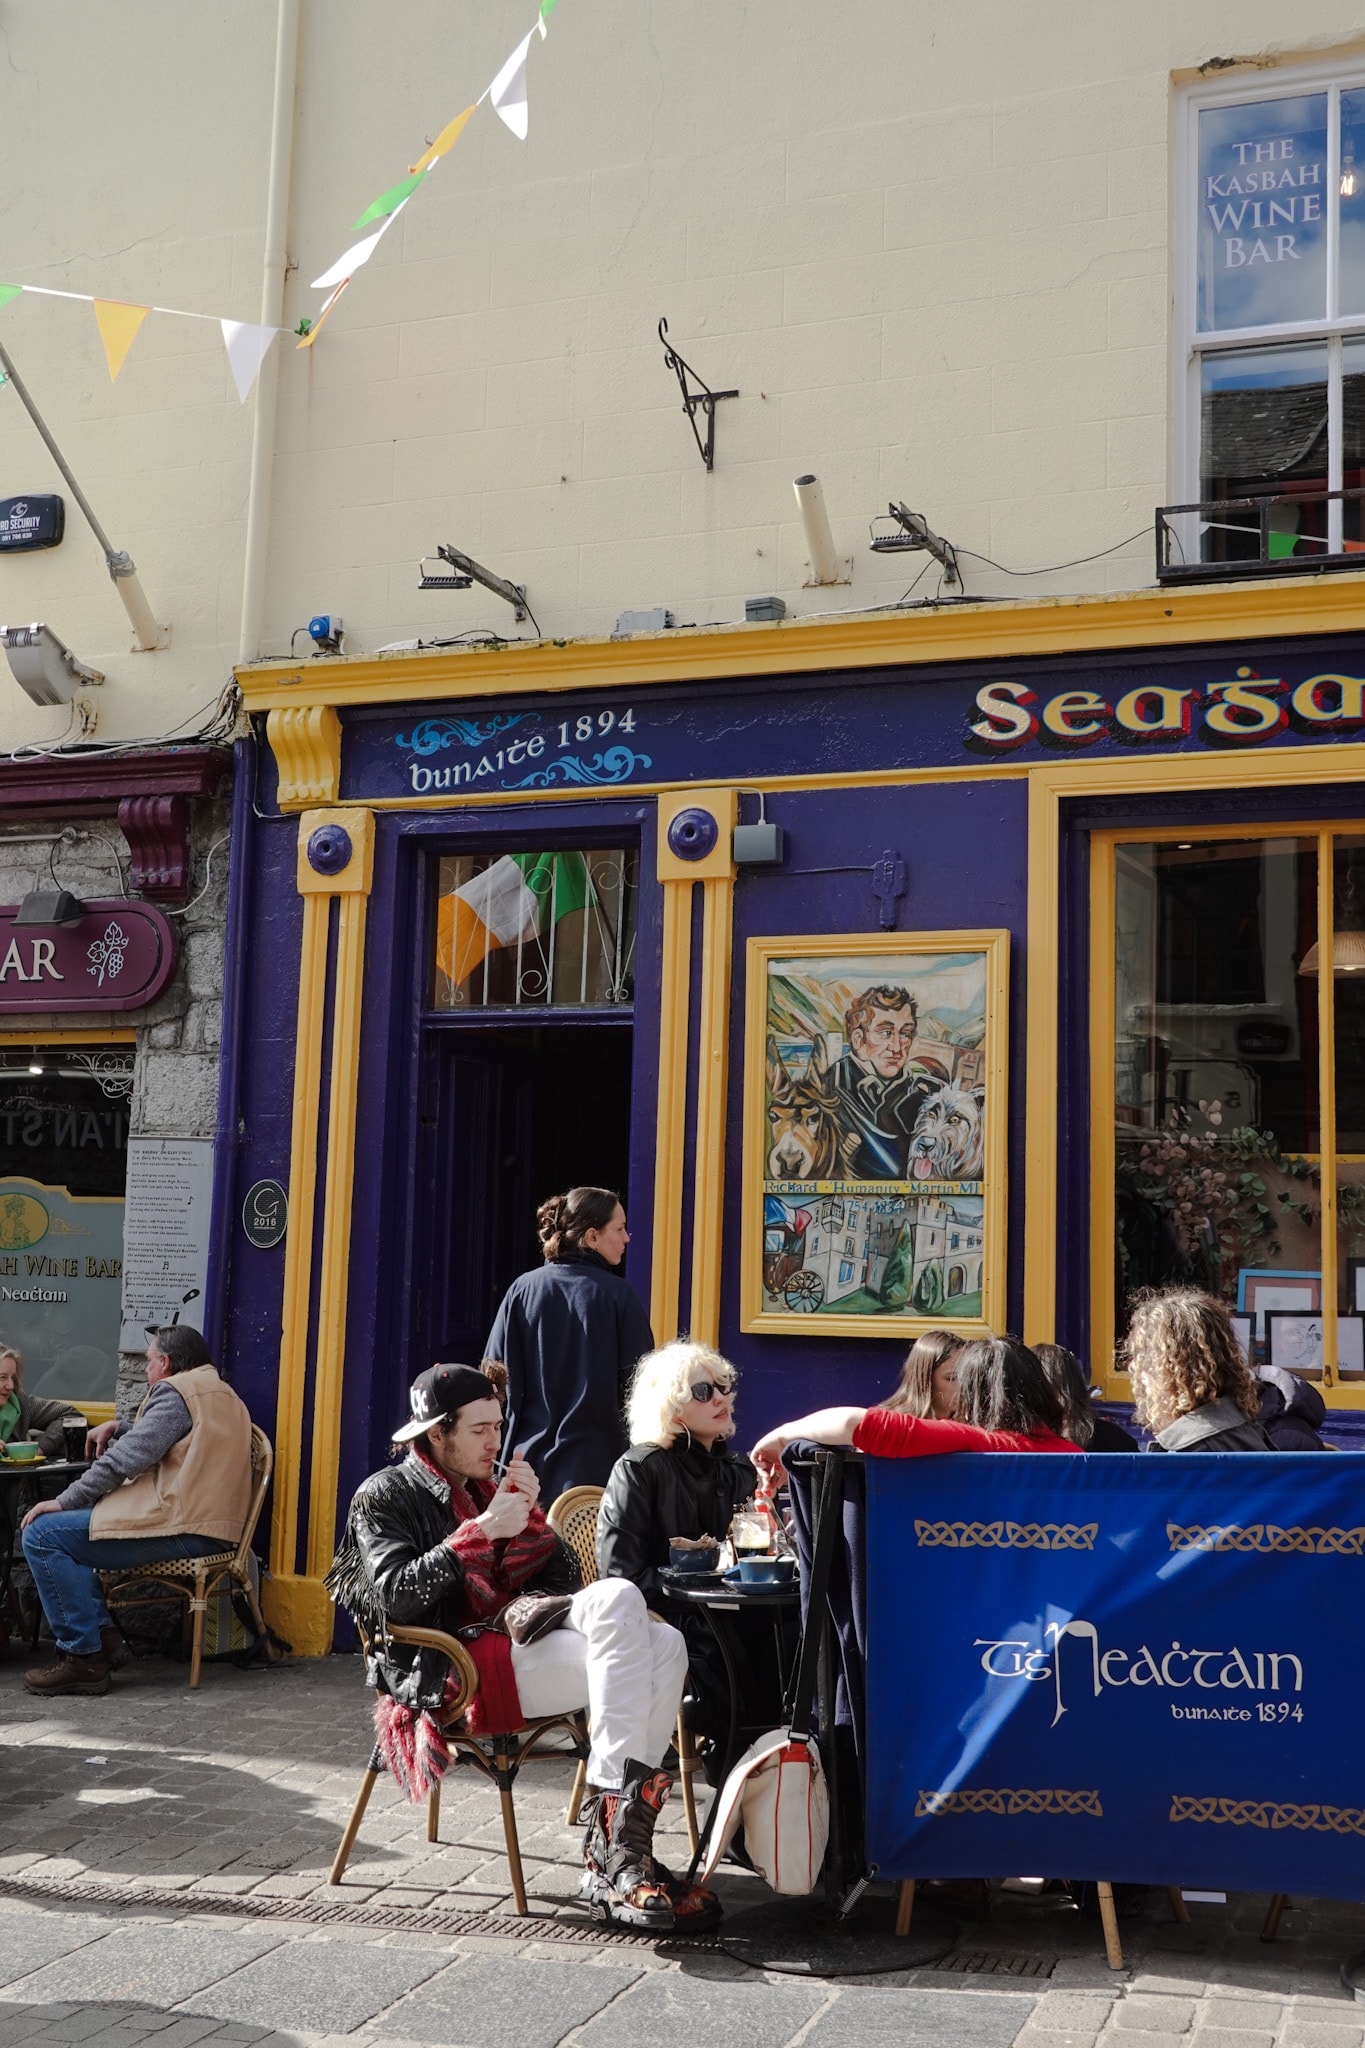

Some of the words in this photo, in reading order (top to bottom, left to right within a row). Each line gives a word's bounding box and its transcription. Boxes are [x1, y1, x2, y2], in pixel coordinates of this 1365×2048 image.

[1231, 138, 1294, 166] THE
[1206, 163, 1321, 199] KASBAH
[1206, 194, 1321, 234] WINE
[1223, 234, 1303, 269] BAR
[10, 516, 41, 530] SECURITY
[557, 708, 638, 749] 1894
[0, 937, 65, 982] AR
[765, 1181, 817, 1193] Richard
[910, 1181, 954, 1194] Martin
[253, 1217, 277, 1227] 2016
[0, 1256, 17, 1276] H
[24, 1254, 78, 1277] WINE
[85, 1256, 122, 1278] BAR
[1255, 1701, 1304, 1723] 1894
